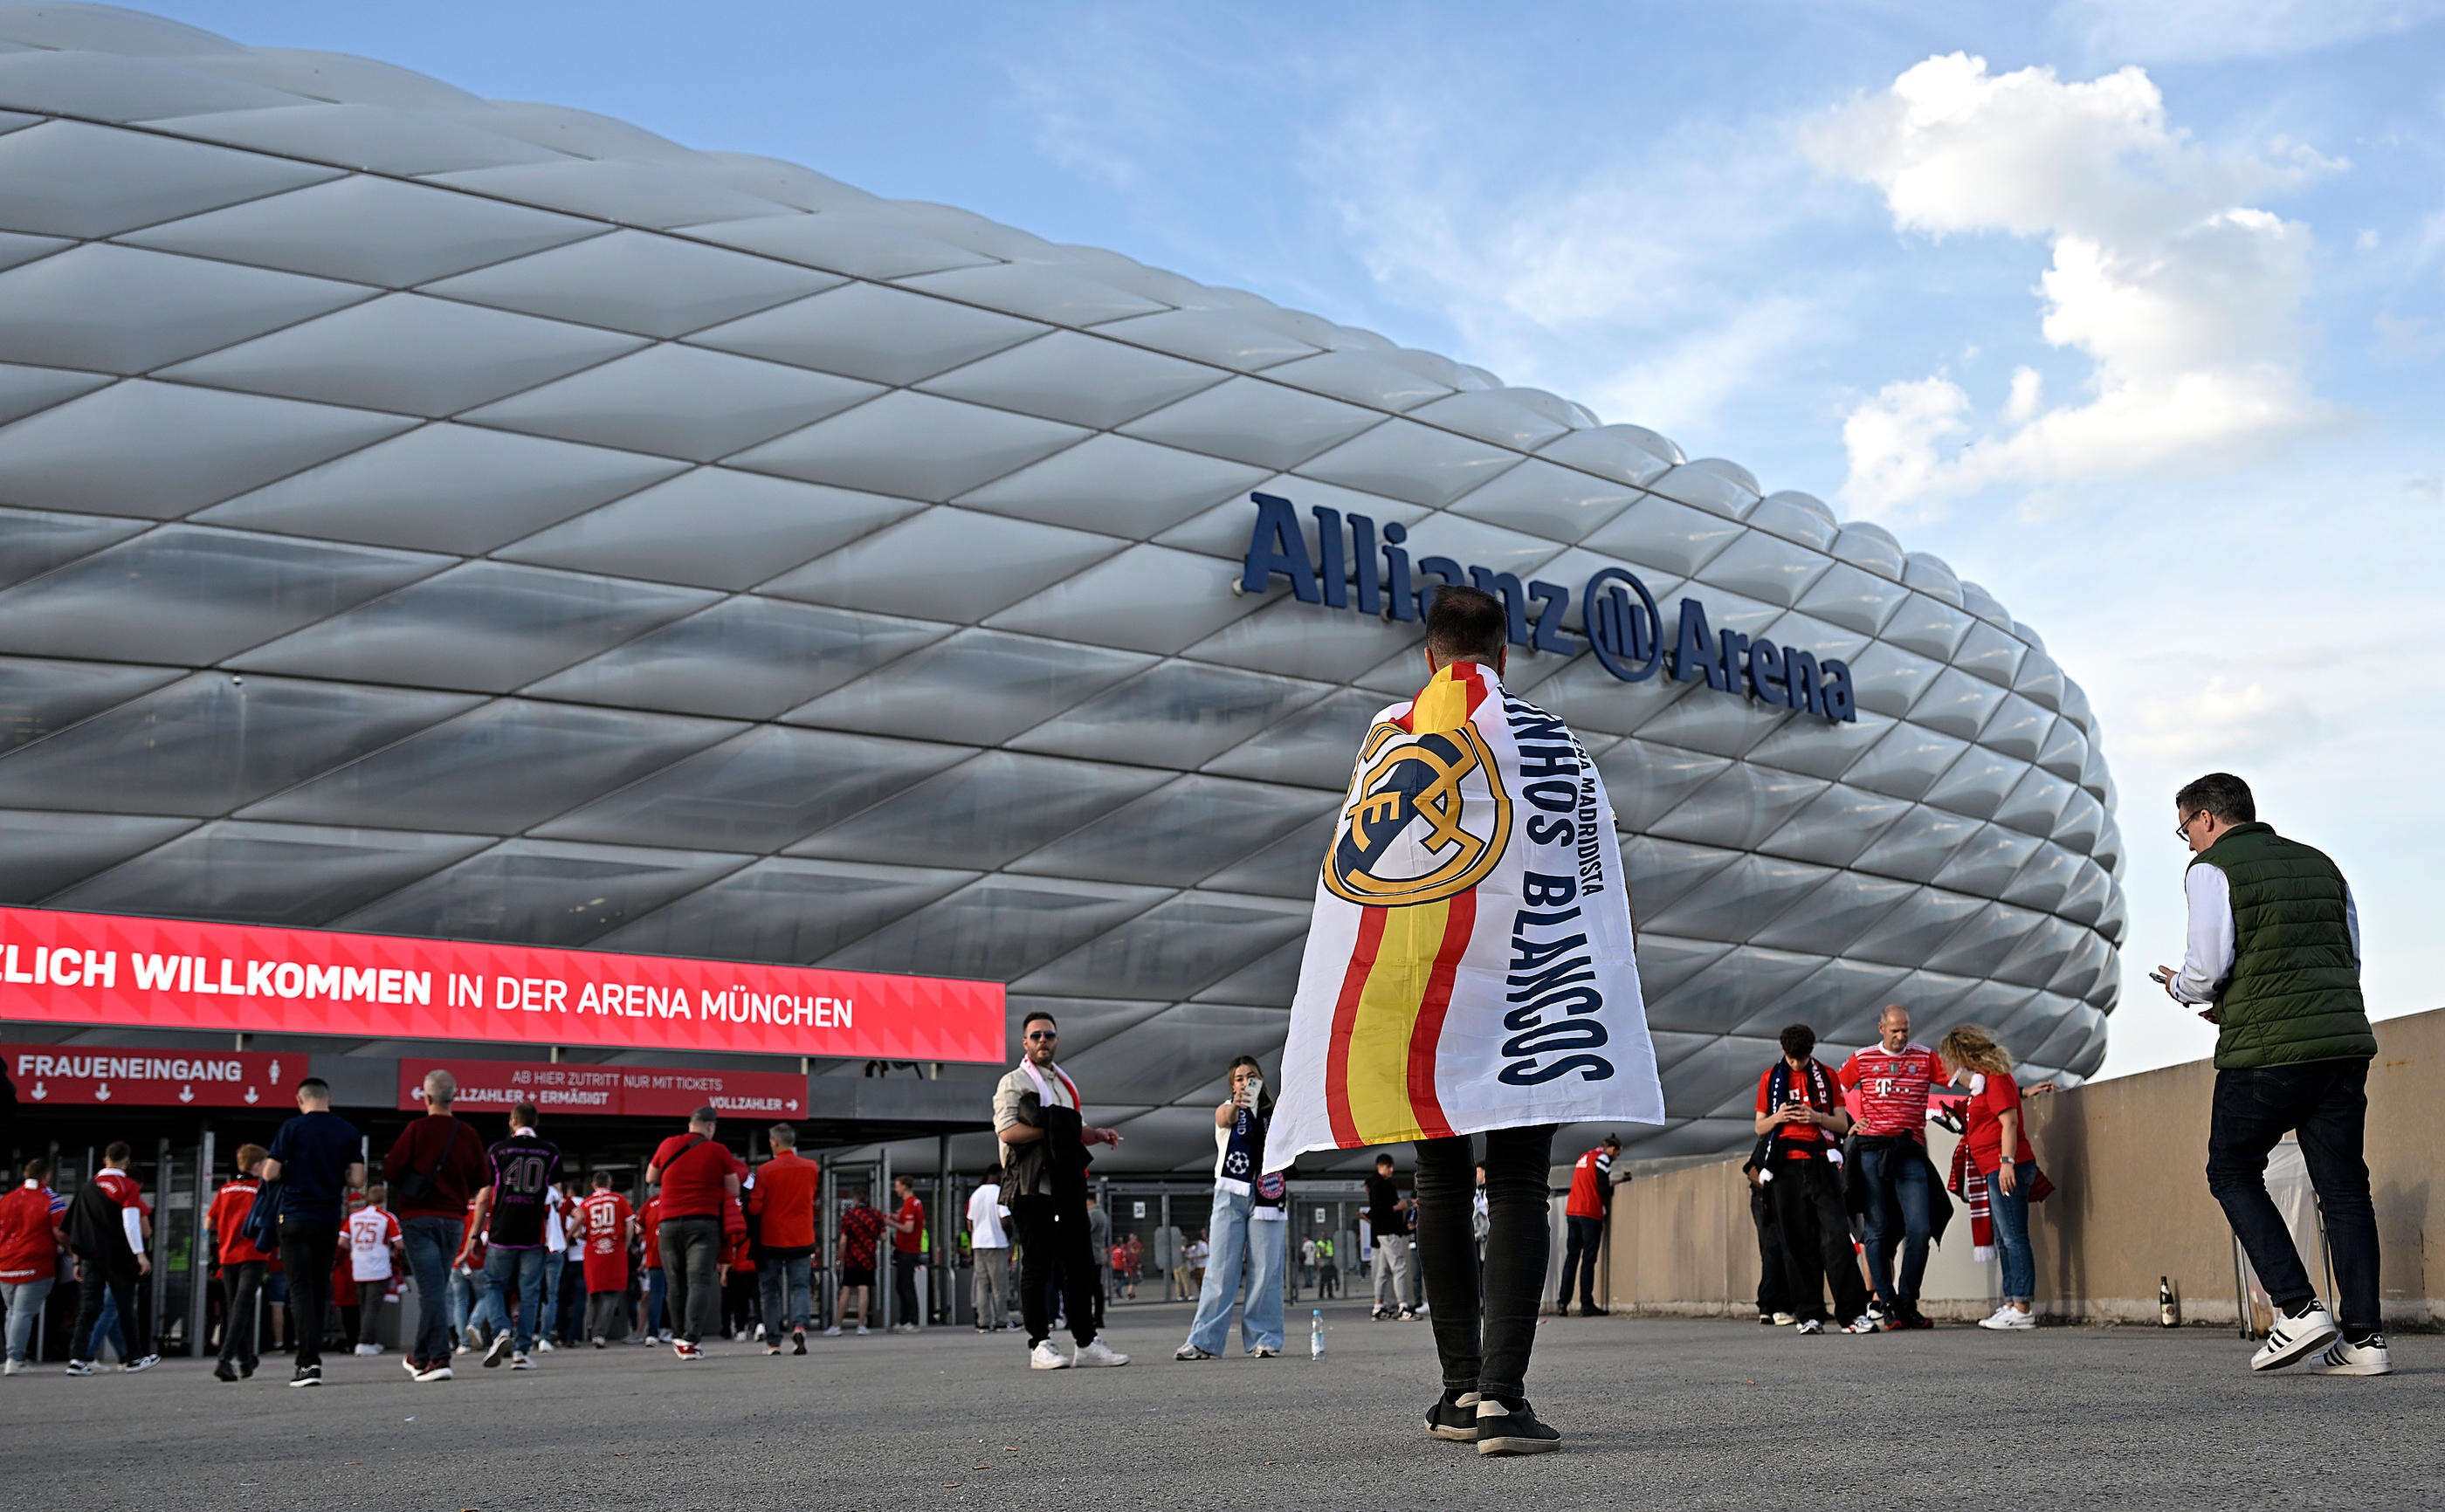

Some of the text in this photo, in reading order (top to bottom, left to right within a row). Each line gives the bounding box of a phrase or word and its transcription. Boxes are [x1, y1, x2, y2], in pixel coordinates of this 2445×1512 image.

[1241, 491, 1859, 725] Allianz Arena
[1577, 777, 1606, 897] MADRIDISTA
[0, 945, 853, 1027] LICH WILLKOMMEN IN DER ARENA MÜNCHEN
[1497, 870, 1615, 1086] BLANCOS
[17, 1054, 243, 1082] FRAUENEINGANG
[511, 1070, 723, 1091] AB HIER ZUTRITT NUR MIT TICKETS
[502, 1156, 546, 1193] 40
[354, 1221, 378, 1244] 25
[589, 1202, 616, 1229] 50
